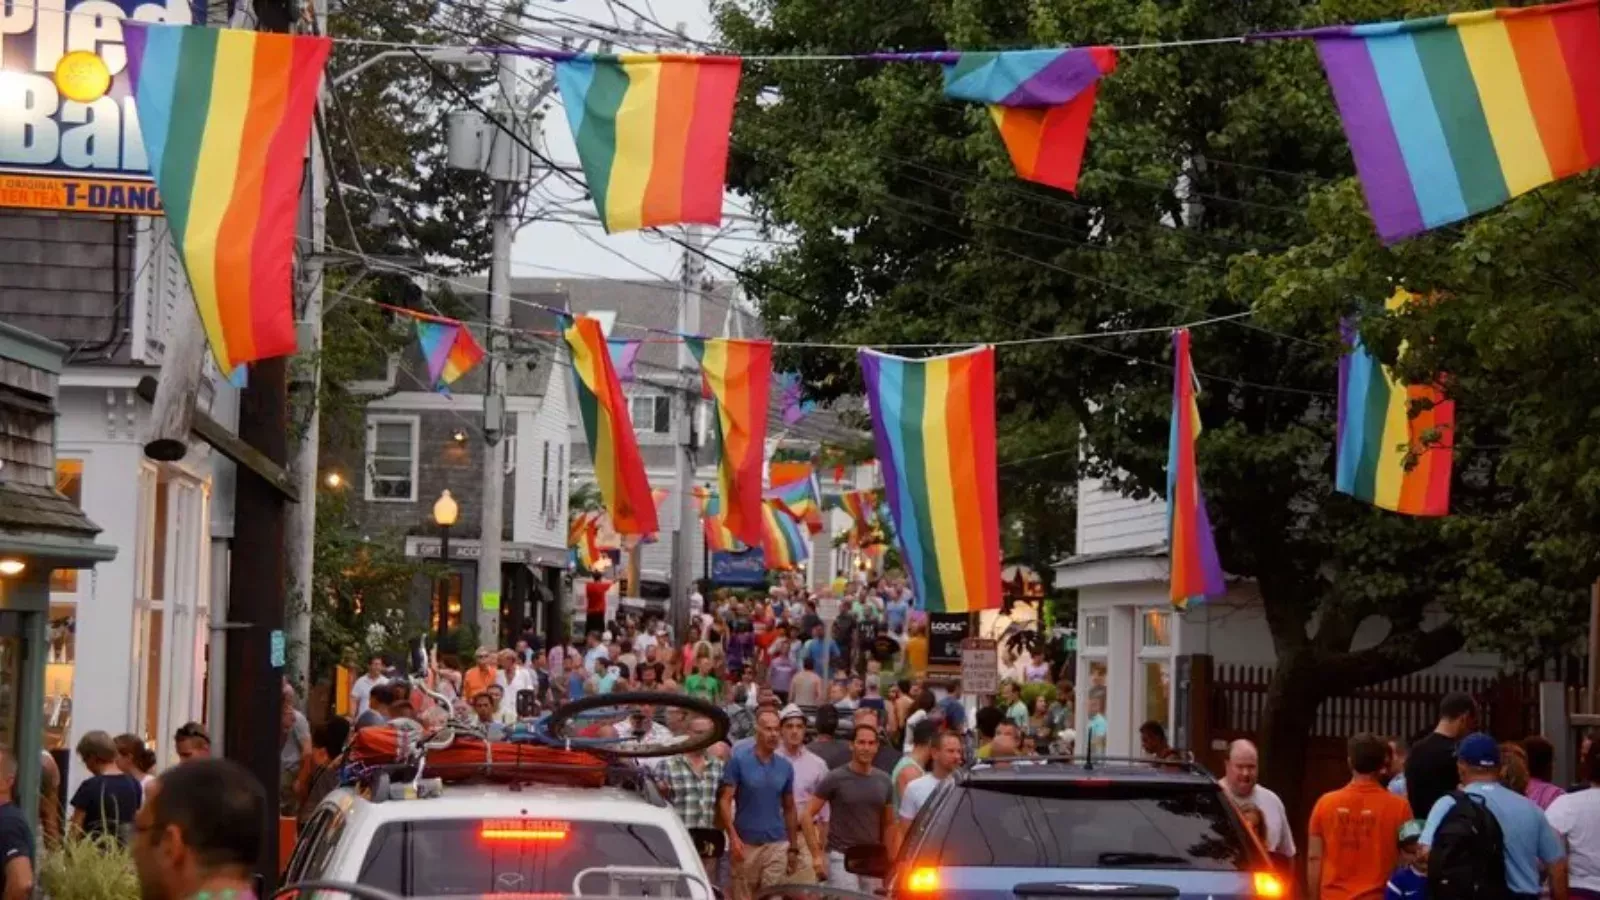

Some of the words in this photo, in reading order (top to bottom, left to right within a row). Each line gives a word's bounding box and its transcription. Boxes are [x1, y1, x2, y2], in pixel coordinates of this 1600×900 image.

[0, 0, 192, 76] Pie
[6, 179, 60, 191] ORIGINAL
[33, 190, 61, 206] TEA
